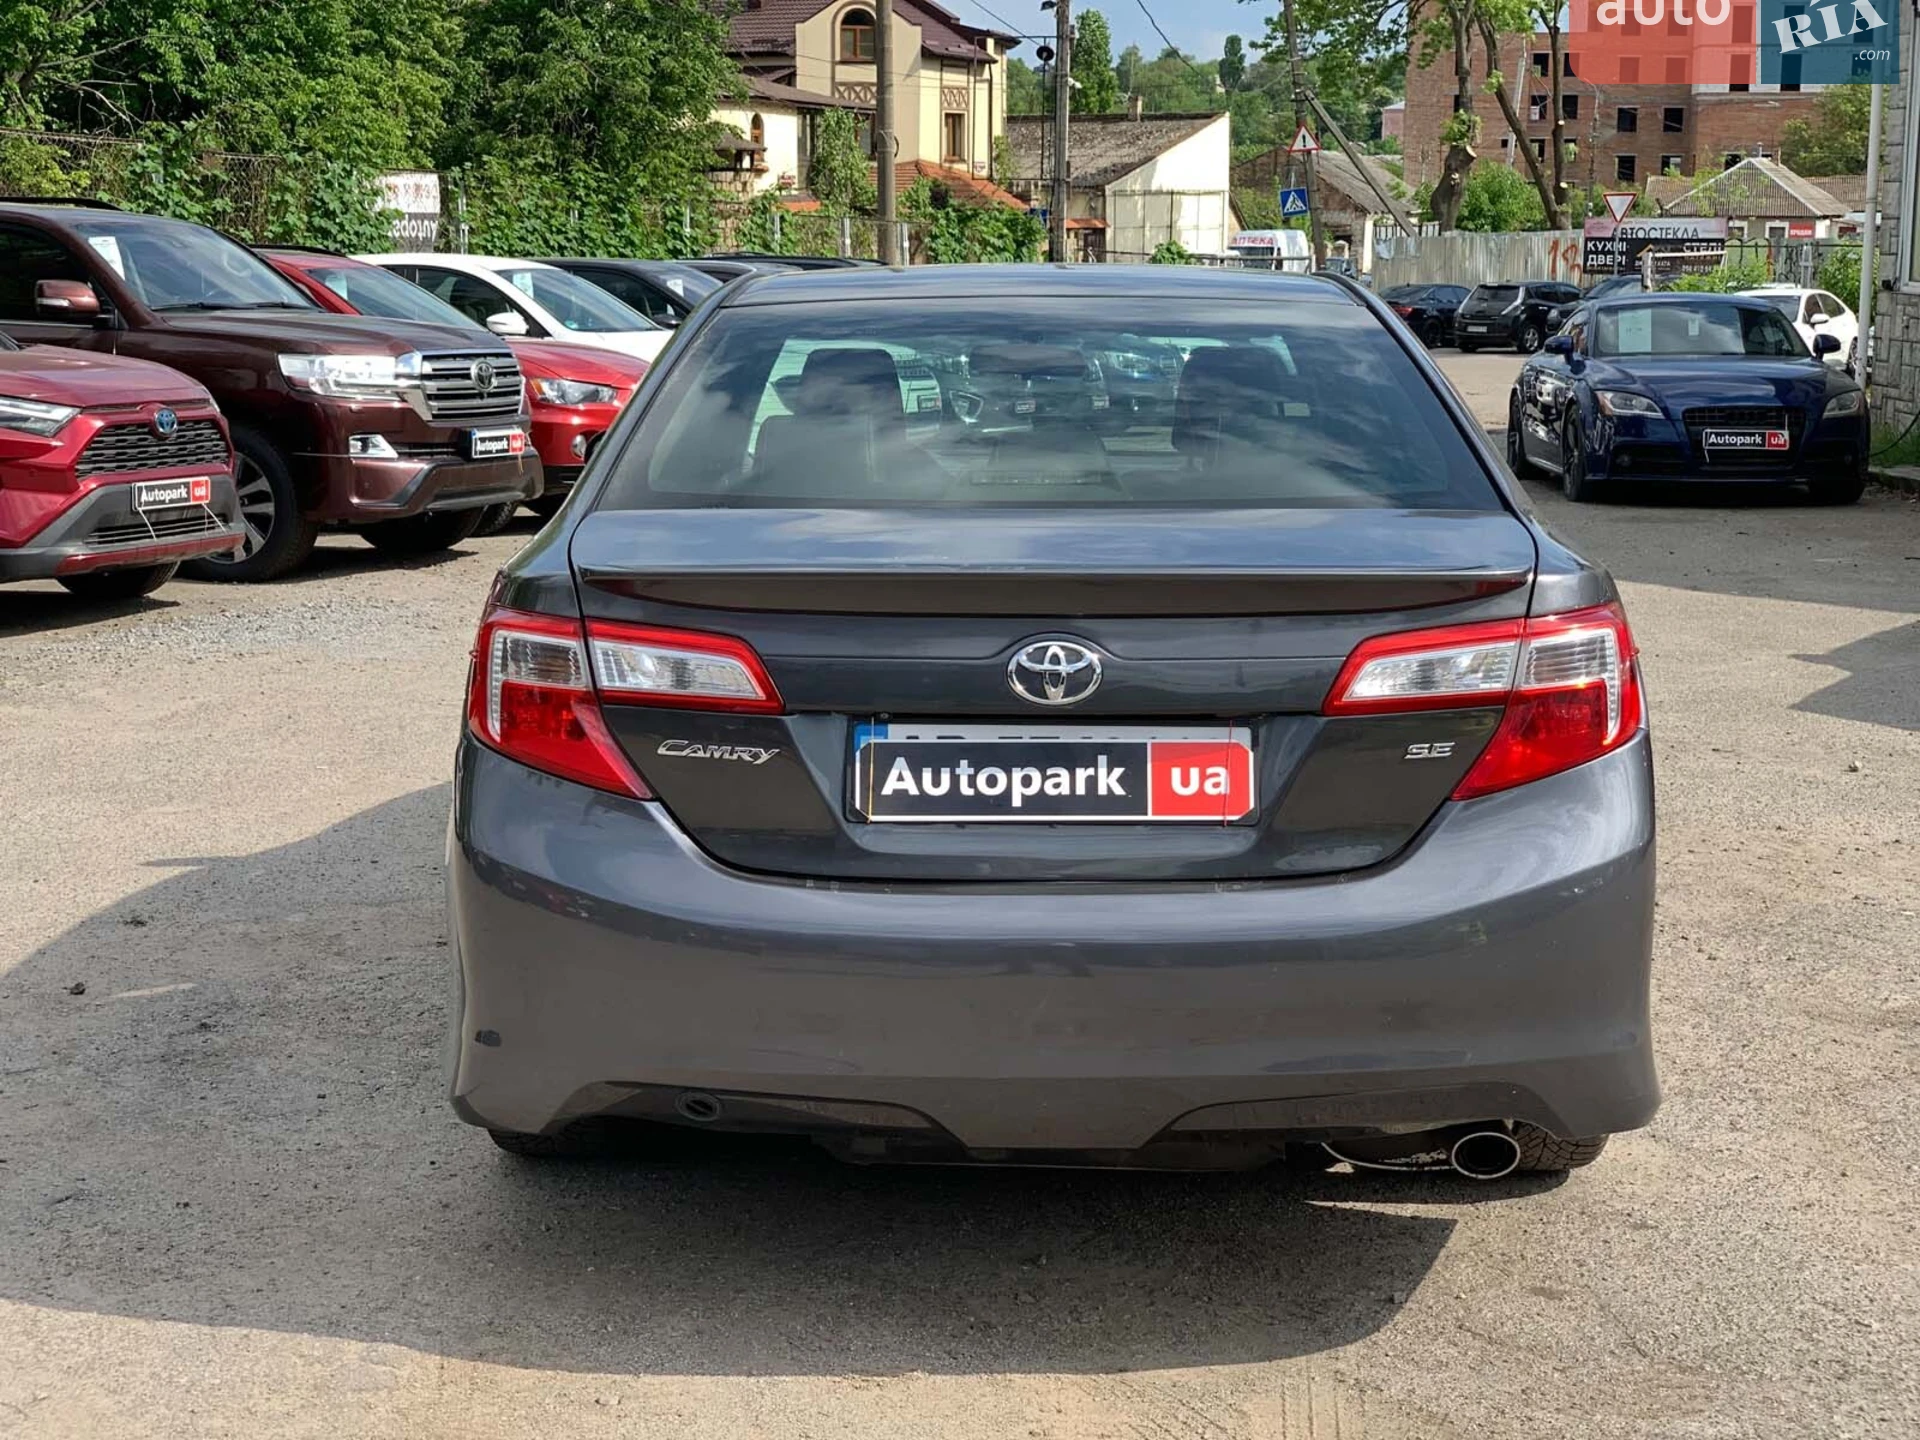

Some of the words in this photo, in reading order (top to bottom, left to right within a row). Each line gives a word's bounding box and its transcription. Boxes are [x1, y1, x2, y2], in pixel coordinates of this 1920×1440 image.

[1708, 433, 1762, 446] Autopark
[140, 485, 188, 504] Autopark
[657, 740, 780, 764] CAMRY
[1404, 741, 1456, 760] SE
[880, 754, 1127, 807] Autopark
[1170, 766, 1228, 796] ua
